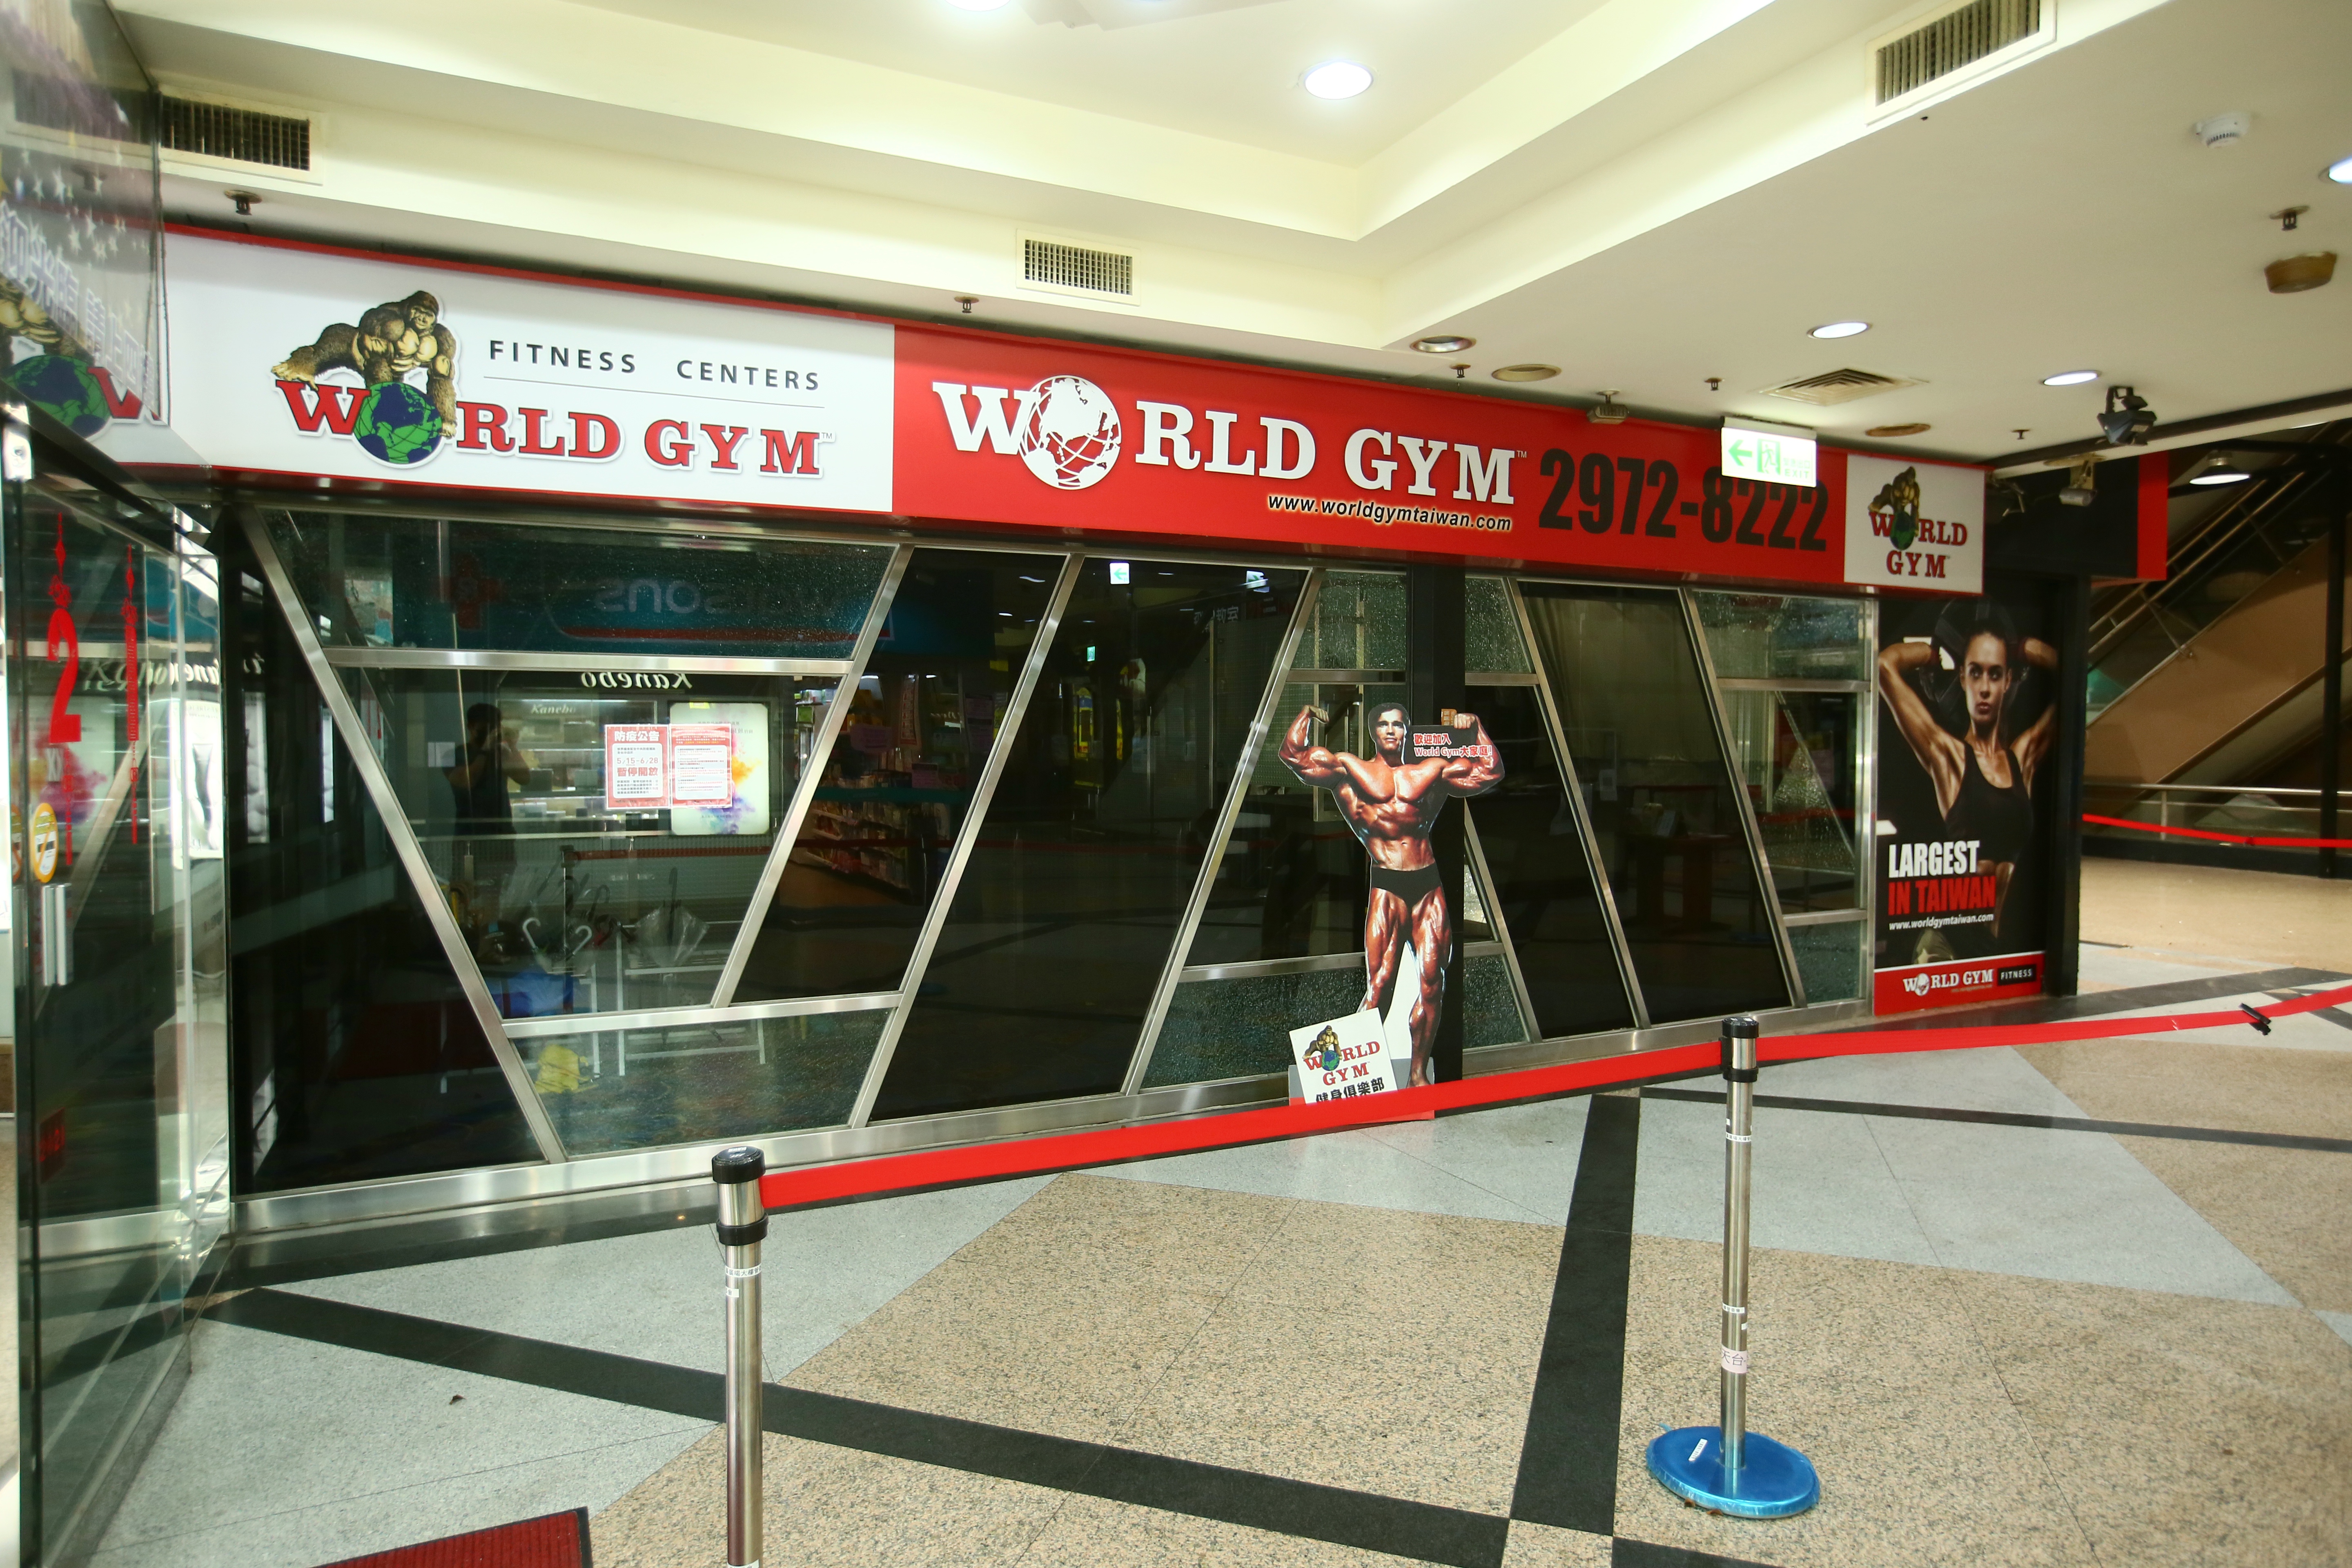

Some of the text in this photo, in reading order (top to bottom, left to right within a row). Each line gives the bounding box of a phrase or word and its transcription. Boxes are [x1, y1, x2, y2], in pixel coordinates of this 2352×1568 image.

[491, 340, 819, 390] FITNESS CENTERS
[276, 380, 620, 465] WORLD
[645, 420, 820, 474] GYM
[933, 375, 1315, 490] WORLD
[1345, 429, 1515, 504] GYM
[1784, 469, 1809, 479] EXIT
[1539, 447, 1828, 551] 2972-8222
[1268, 494, 1511, 531] www.worldgymtaiwan.com
[1869, 511, 1968, 550] WORLD
[1886, 550, 1946, 578] GYM
[614, 731, 660, 742] 防疫公告
[1413, 733, 1450, 746] 歡迎加入
[1414, 747, 1440, 757] World
[617, 766, 659, 777] 暫停開放
[1889, 840, 1980, 878] LARGEST
[1888, 875, 1996, 916] IN TAIWAN
[1889, 913, 1994, 930] www.worldgymtaiwan.com
[1962, 969, 1994, 986] GYM
[2000, 968, 2033, 980] FITNESS
[1304, 1041, 1381, 1071] WORLD
[1323, 1063, 1370, 1086] GYM
[726, 1266, 762, 1276] 廣場大樓管
[1722, 1349, 1746, 1366] 天台
